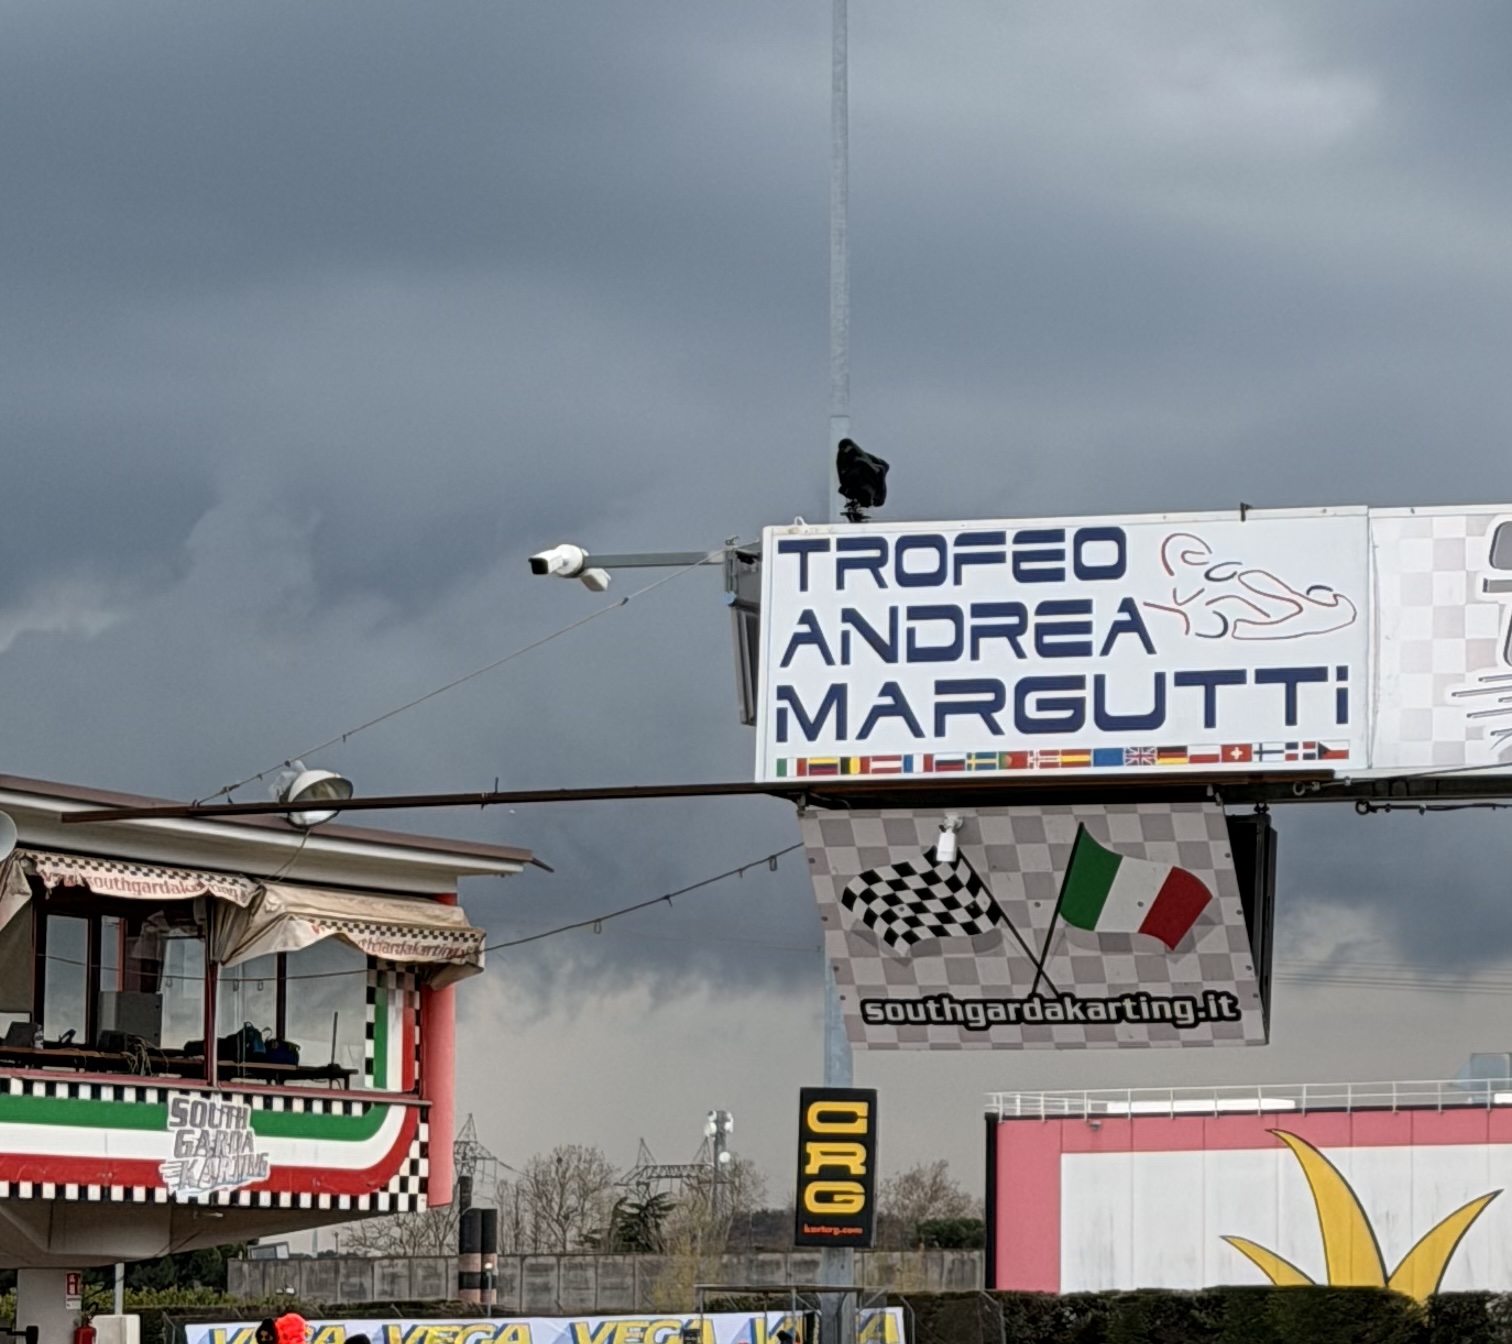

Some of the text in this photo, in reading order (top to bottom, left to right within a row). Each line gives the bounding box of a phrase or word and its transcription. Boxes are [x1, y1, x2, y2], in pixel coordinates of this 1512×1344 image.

[777, 526, 1127, 592] TROFEO
[779, 596, 1157, 668] ANDREA
[863, 992, 1238, 1027] southgardakarting.it
[169, 1097, 249, 1130] SOUTH
[174, 1129, 255, 1158] GARDA
[804, 1101, 869, 1214] CRG
[178, 1152, 270, 1191] KARTING
